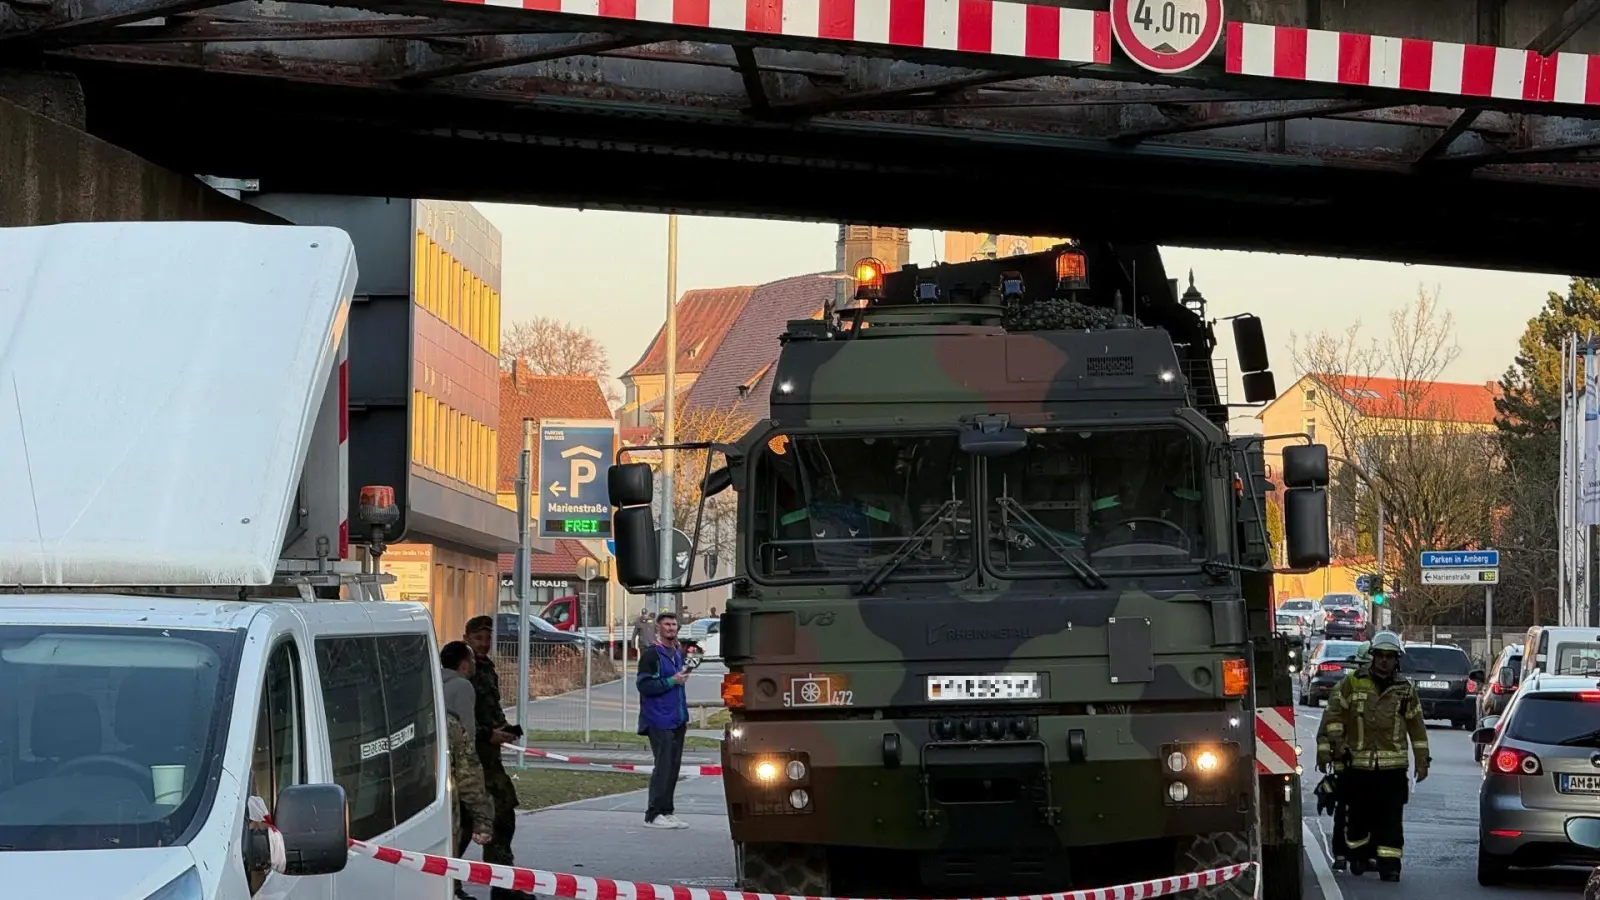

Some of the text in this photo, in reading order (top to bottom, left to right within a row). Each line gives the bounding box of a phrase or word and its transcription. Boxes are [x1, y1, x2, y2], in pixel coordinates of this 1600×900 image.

[569, 459, 597, 498] P
[548, 502, 608, 514] Marienstraße
[564, 519, 598, 533] FREI
[1430, 554, 1489, 565] Parken in Amberg
[1432, 572, 1471, 581] Marienstraße
[532, 580, 568, 588] KRAUS
[783, 691, 853, 707] 5 472
[1570, 777, 1586, 788] AM
